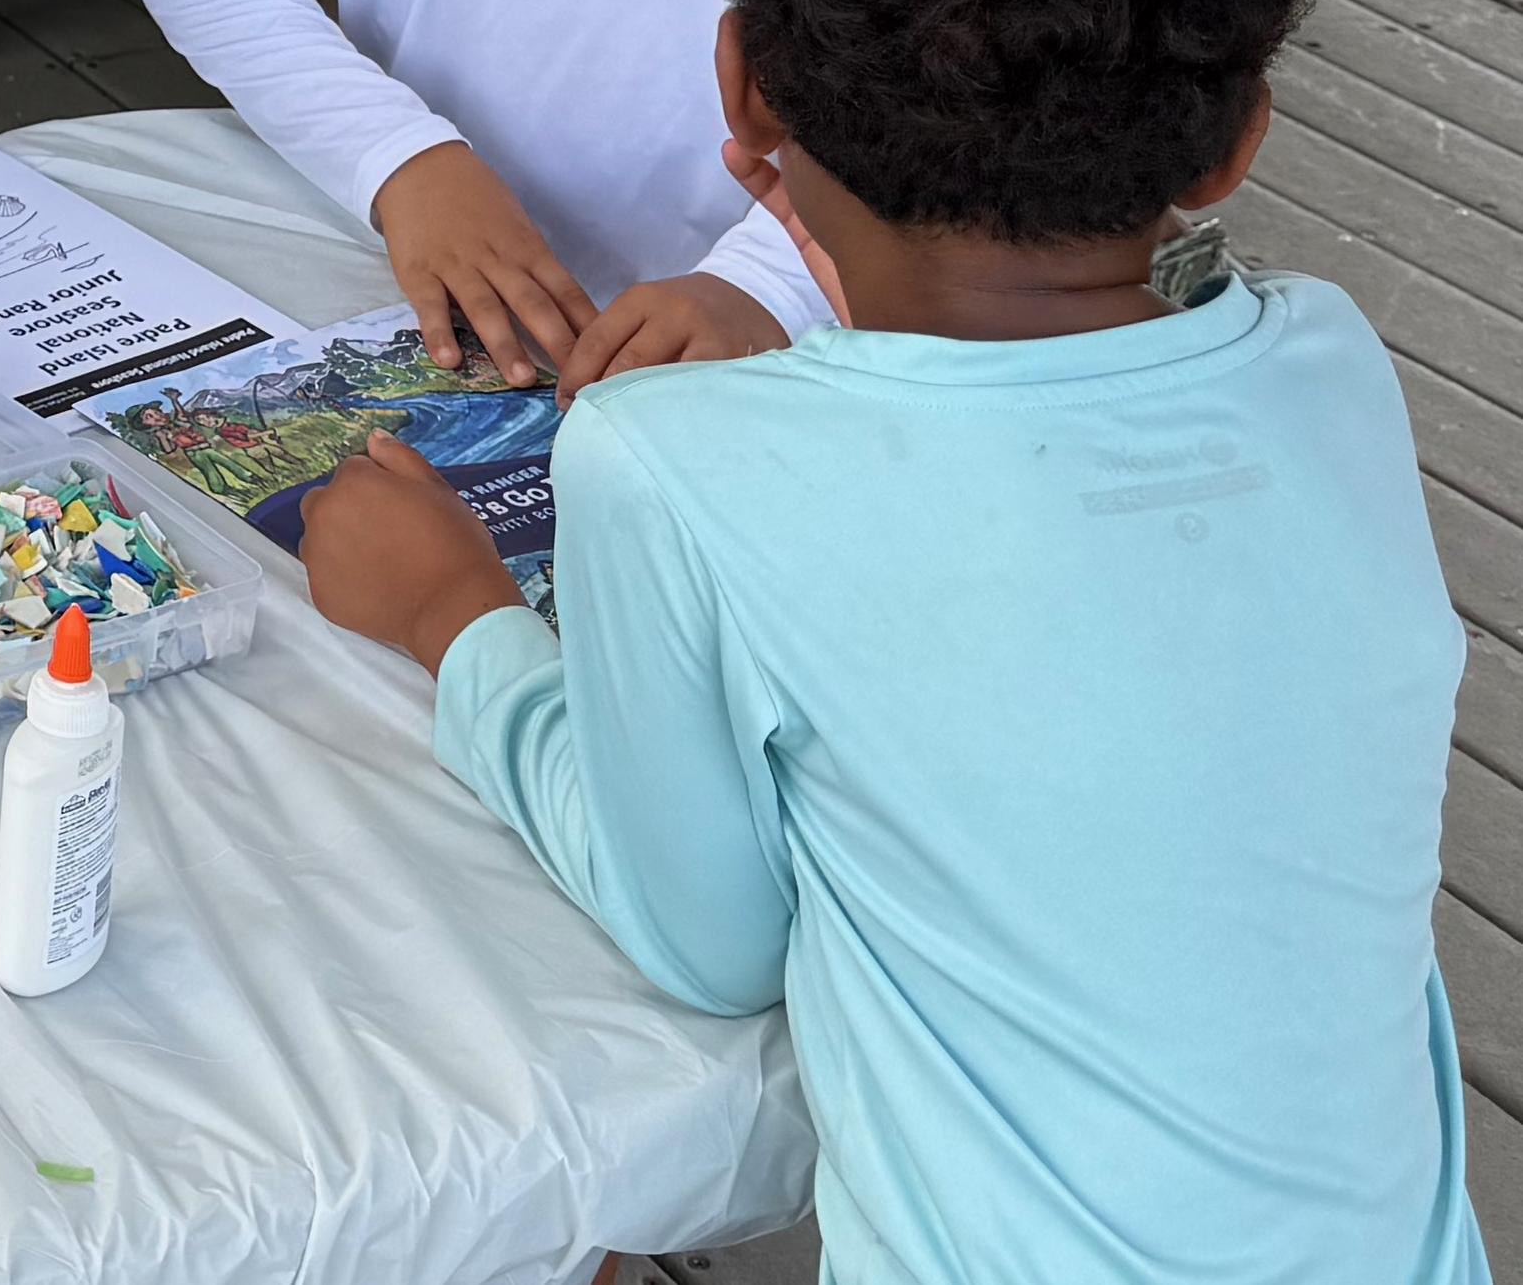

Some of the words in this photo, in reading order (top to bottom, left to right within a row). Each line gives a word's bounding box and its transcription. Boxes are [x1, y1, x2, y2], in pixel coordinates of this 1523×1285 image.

[47, 268, 123, 304] Junior
[8, 295, 122, 337] Seashore
[36, 311, 145, 354] National
[117, 318, 192, 347] Padre
[221, 326, 257, 344] Padre
[38, 343, 119, 377] Island
[187, 339, 224, 357] Island
[90, 366, 144, 389] Seashore
[140, 353, 191, 373] National
[472, 465, 546, 495] RANGER
[488, 514, 532, 535] IVITY
[532, 506, 556, 521] BO
